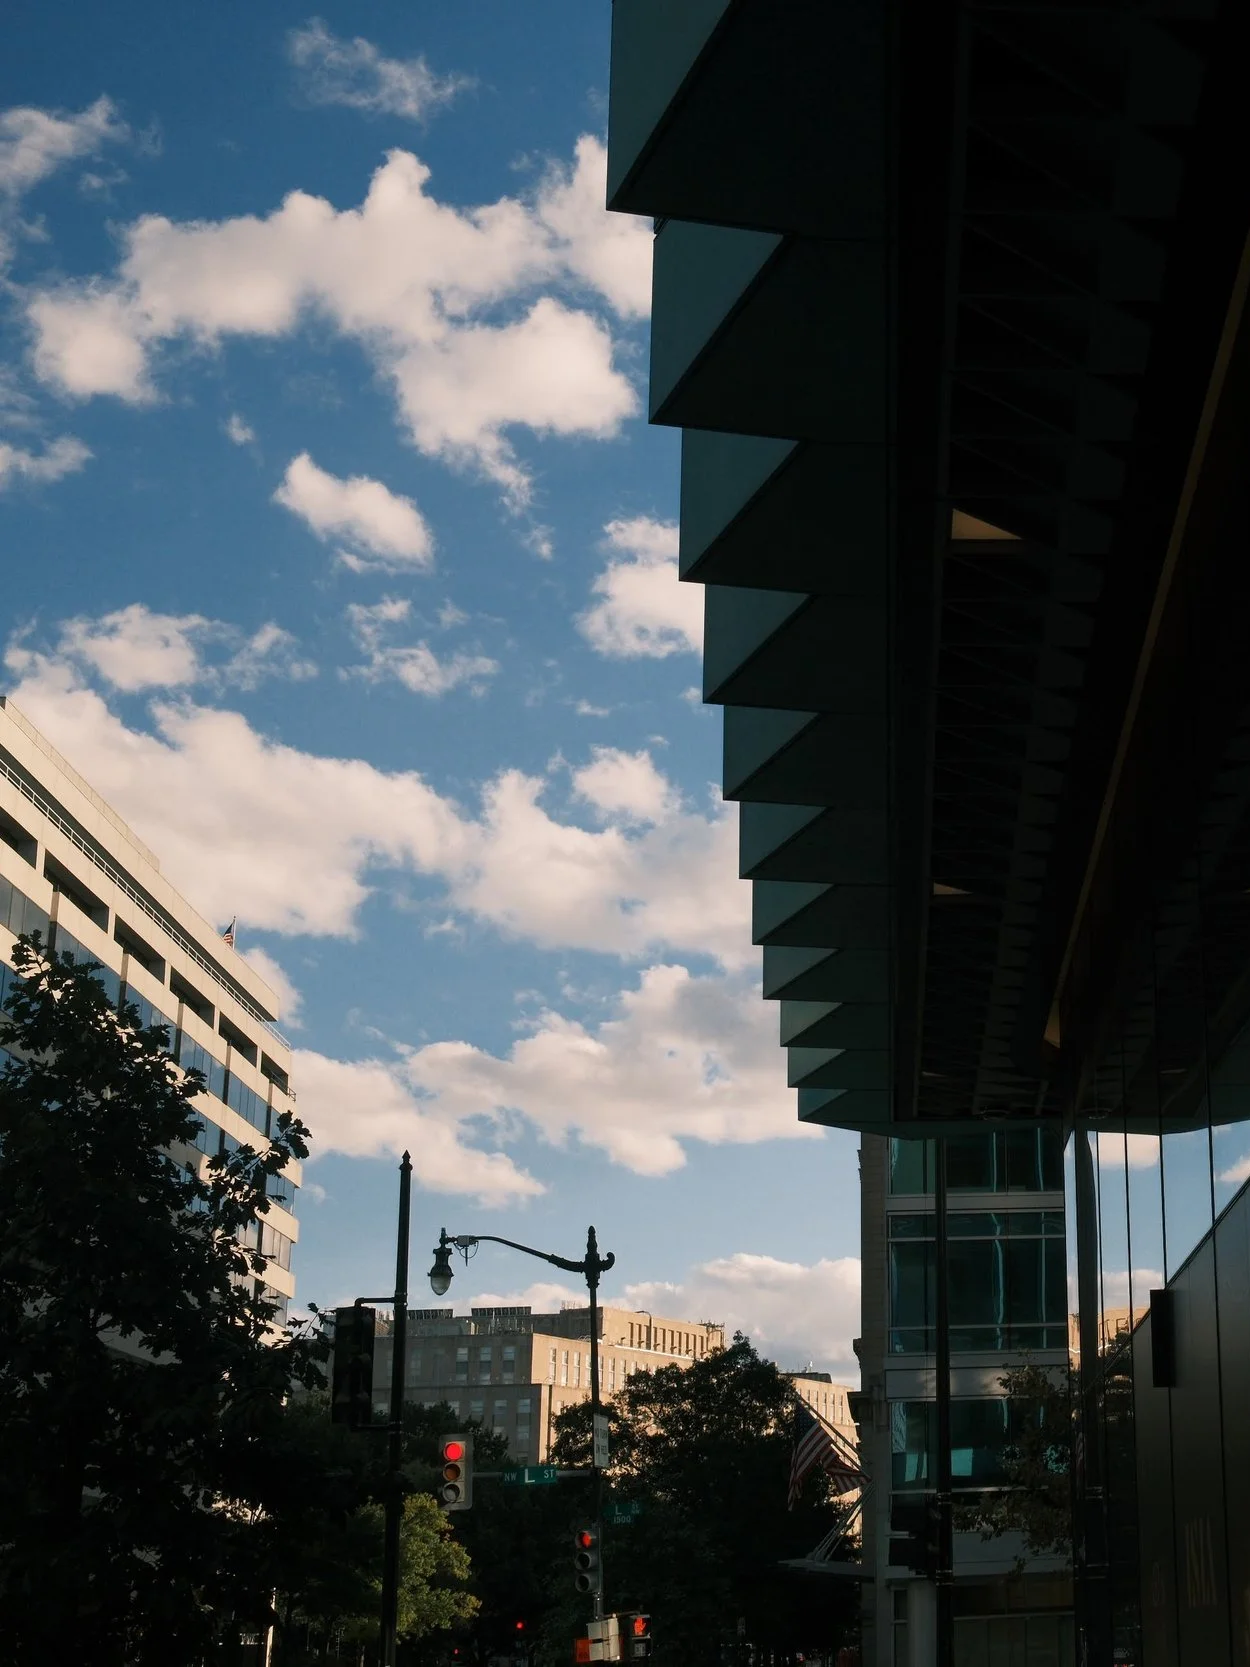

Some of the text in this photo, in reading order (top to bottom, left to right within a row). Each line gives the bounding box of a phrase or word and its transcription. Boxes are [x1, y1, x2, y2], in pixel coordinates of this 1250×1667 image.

[504, 1468, 555, 1483] NW L ST
[615, 1504, 623, 1515] L
